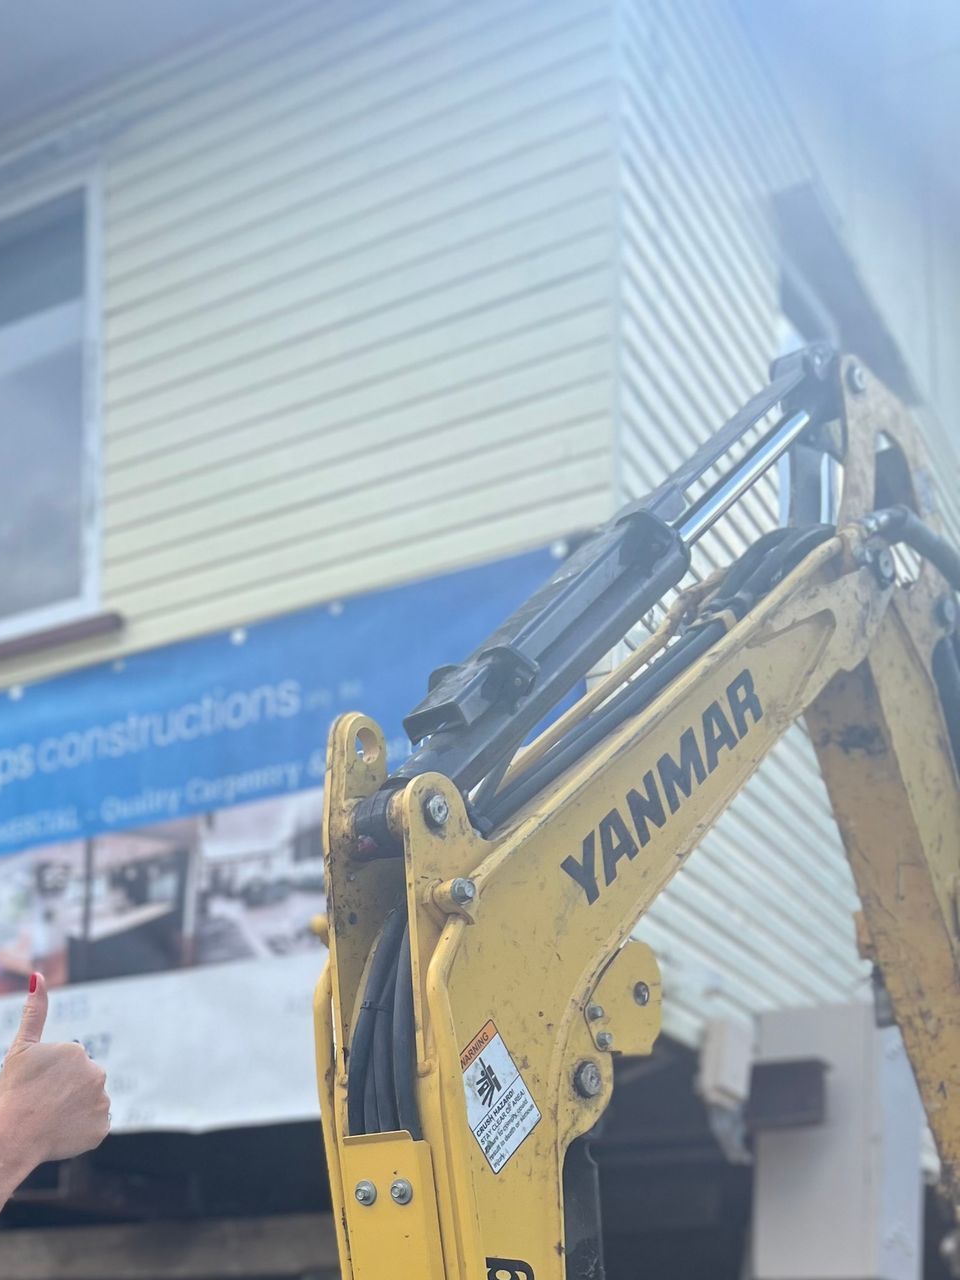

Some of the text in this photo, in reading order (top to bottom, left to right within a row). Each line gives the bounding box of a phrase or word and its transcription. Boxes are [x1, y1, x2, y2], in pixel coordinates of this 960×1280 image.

[37, 679, 302, 773] constructions
[101, 785, 182, 824] Quality
[559, 667, 764, 905] YANMAR
[477, 1088, 515, 1137] CRUSH HAZARD!
[480, 1128, 493, 1146] STAY
[491, 1111, 507, 1132] CLEAR
[511, 1088, 525, 1108] AREA!
